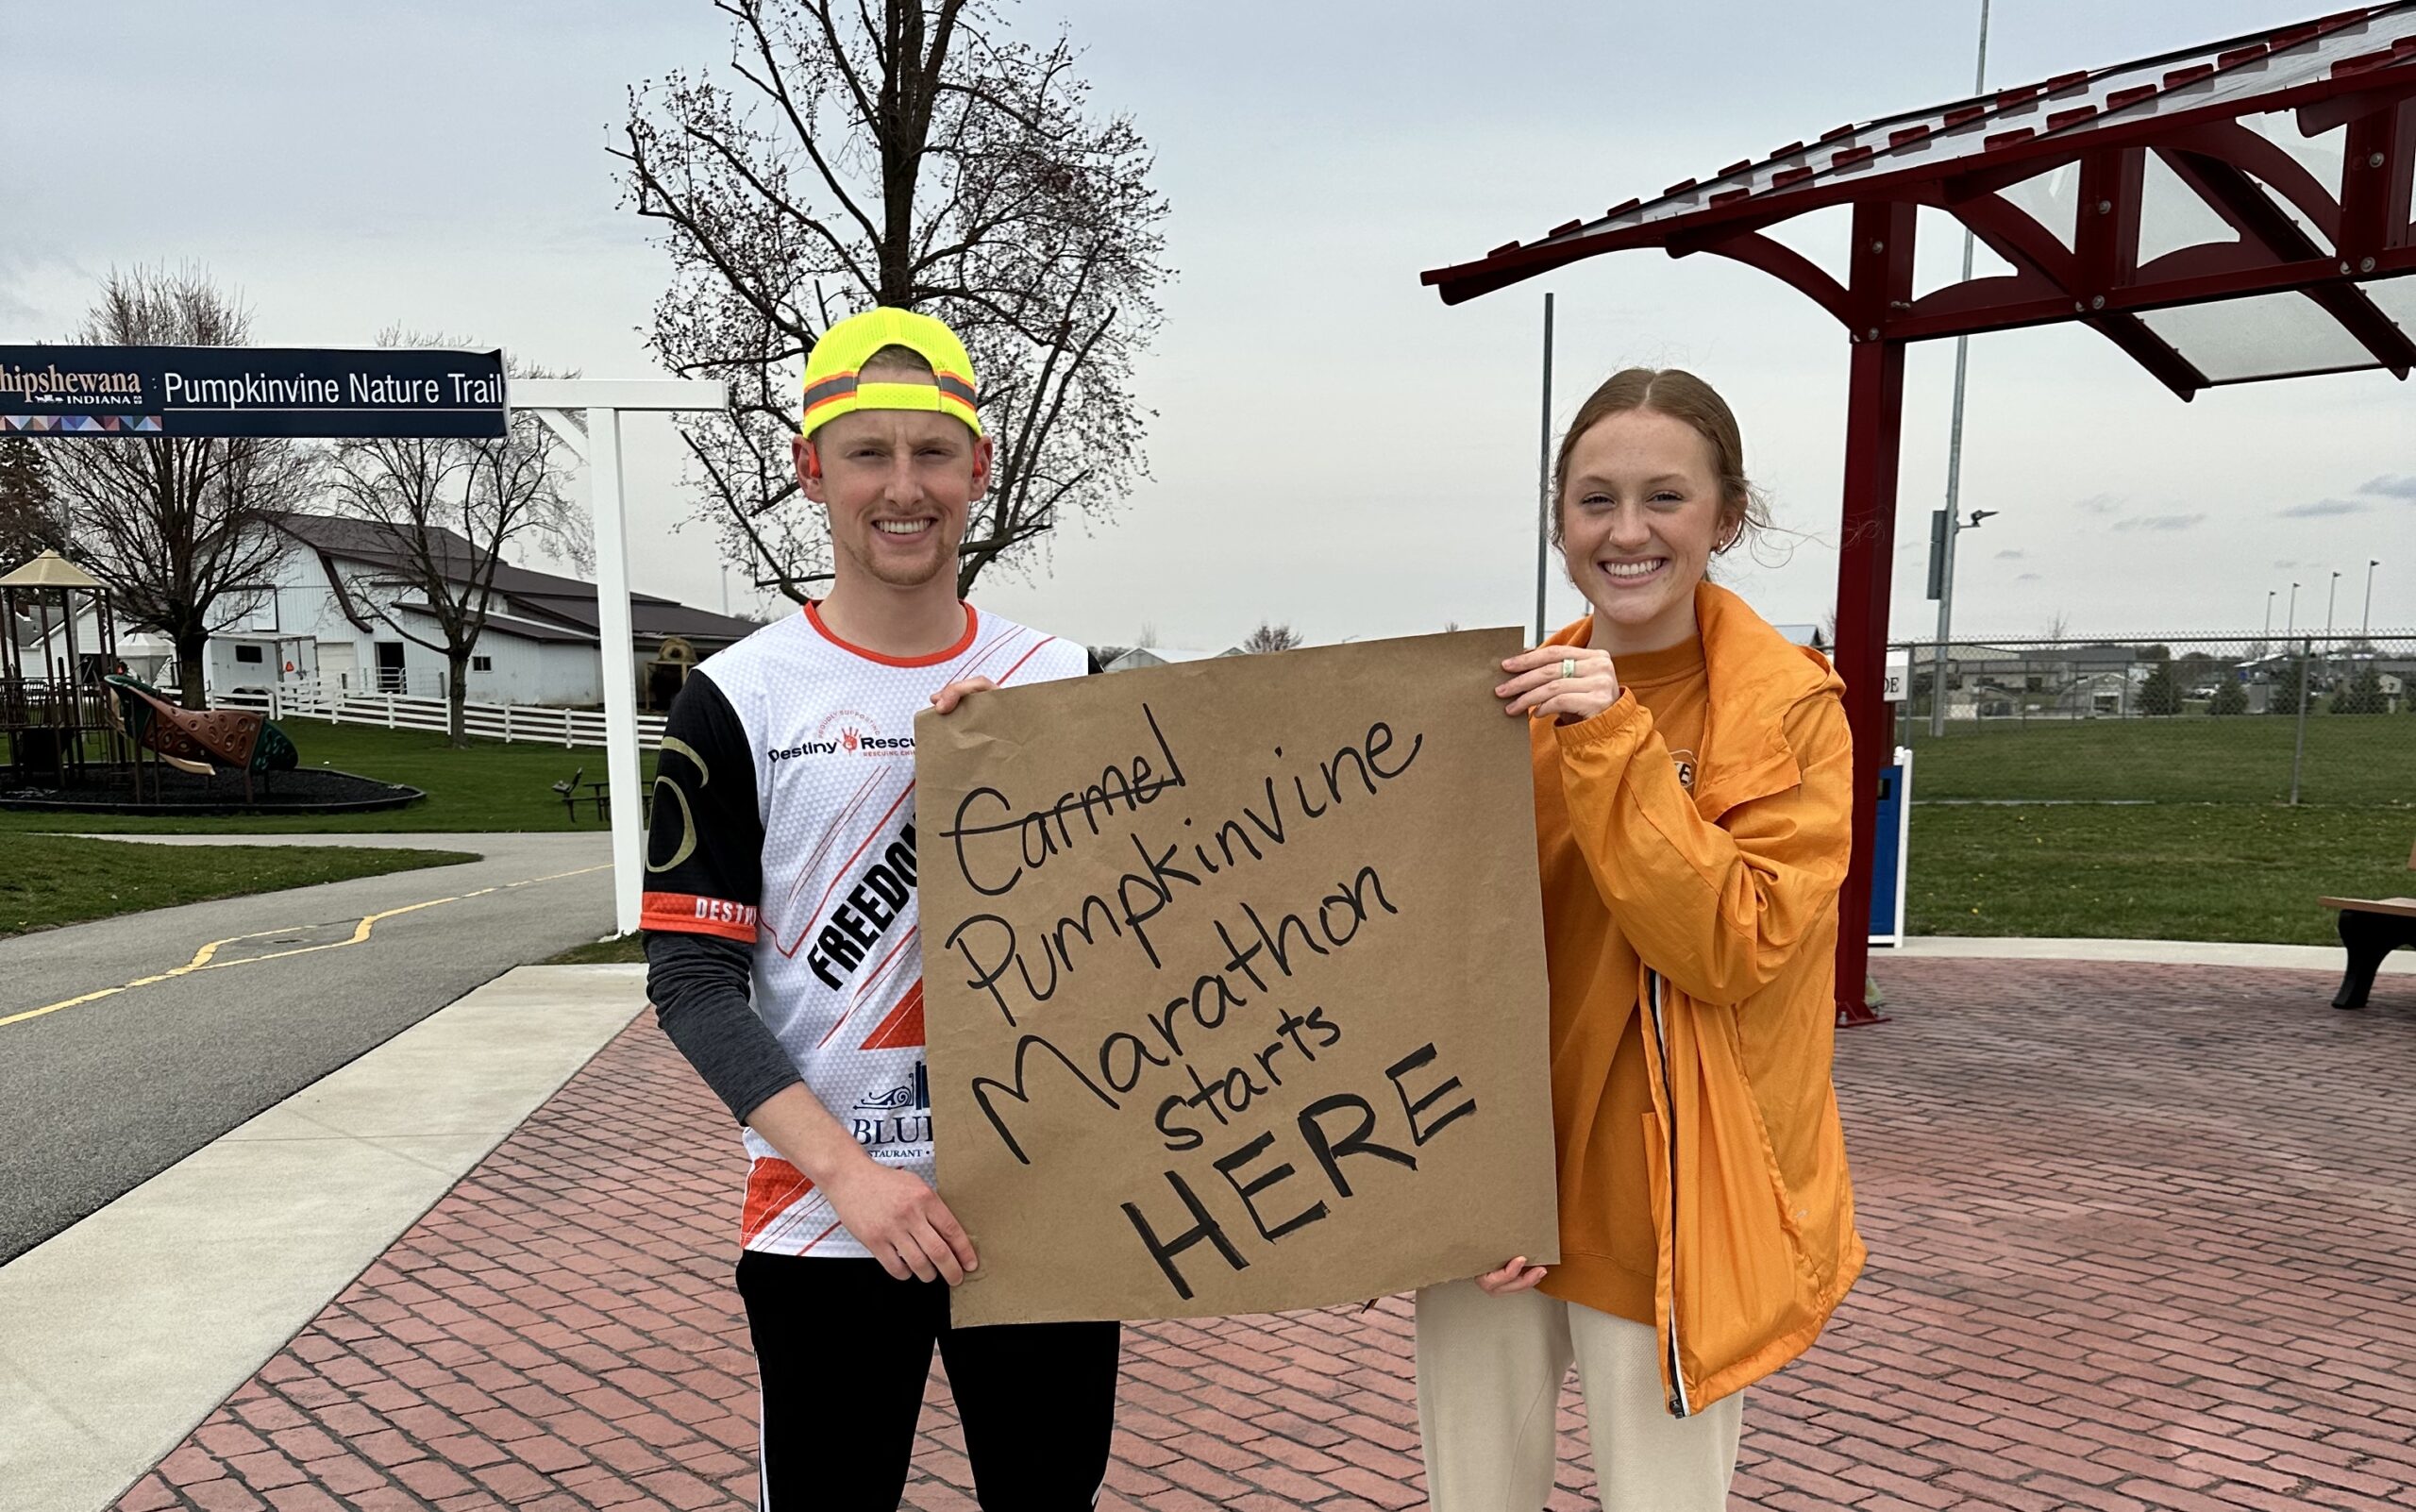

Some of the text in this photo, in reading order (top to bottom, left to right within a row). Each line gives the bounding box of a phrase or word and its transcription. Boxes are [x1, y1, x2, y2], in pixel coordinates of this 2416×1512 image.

[67, 395, 131, 405] INDIANA
[163, 372, 503, 409] Pumpkinvine Nature Trail
[767, 742, 837, 764] Destiny
[940, 703, 1186, 896] Carmel
[945, 722, 1423, 1028] Pumpkinvine
[972, 866, 1399, 1166] Marathon
[1154, 1006, 1342, 1151] starts
[1120, 1042, 1477, 1301] HERE
